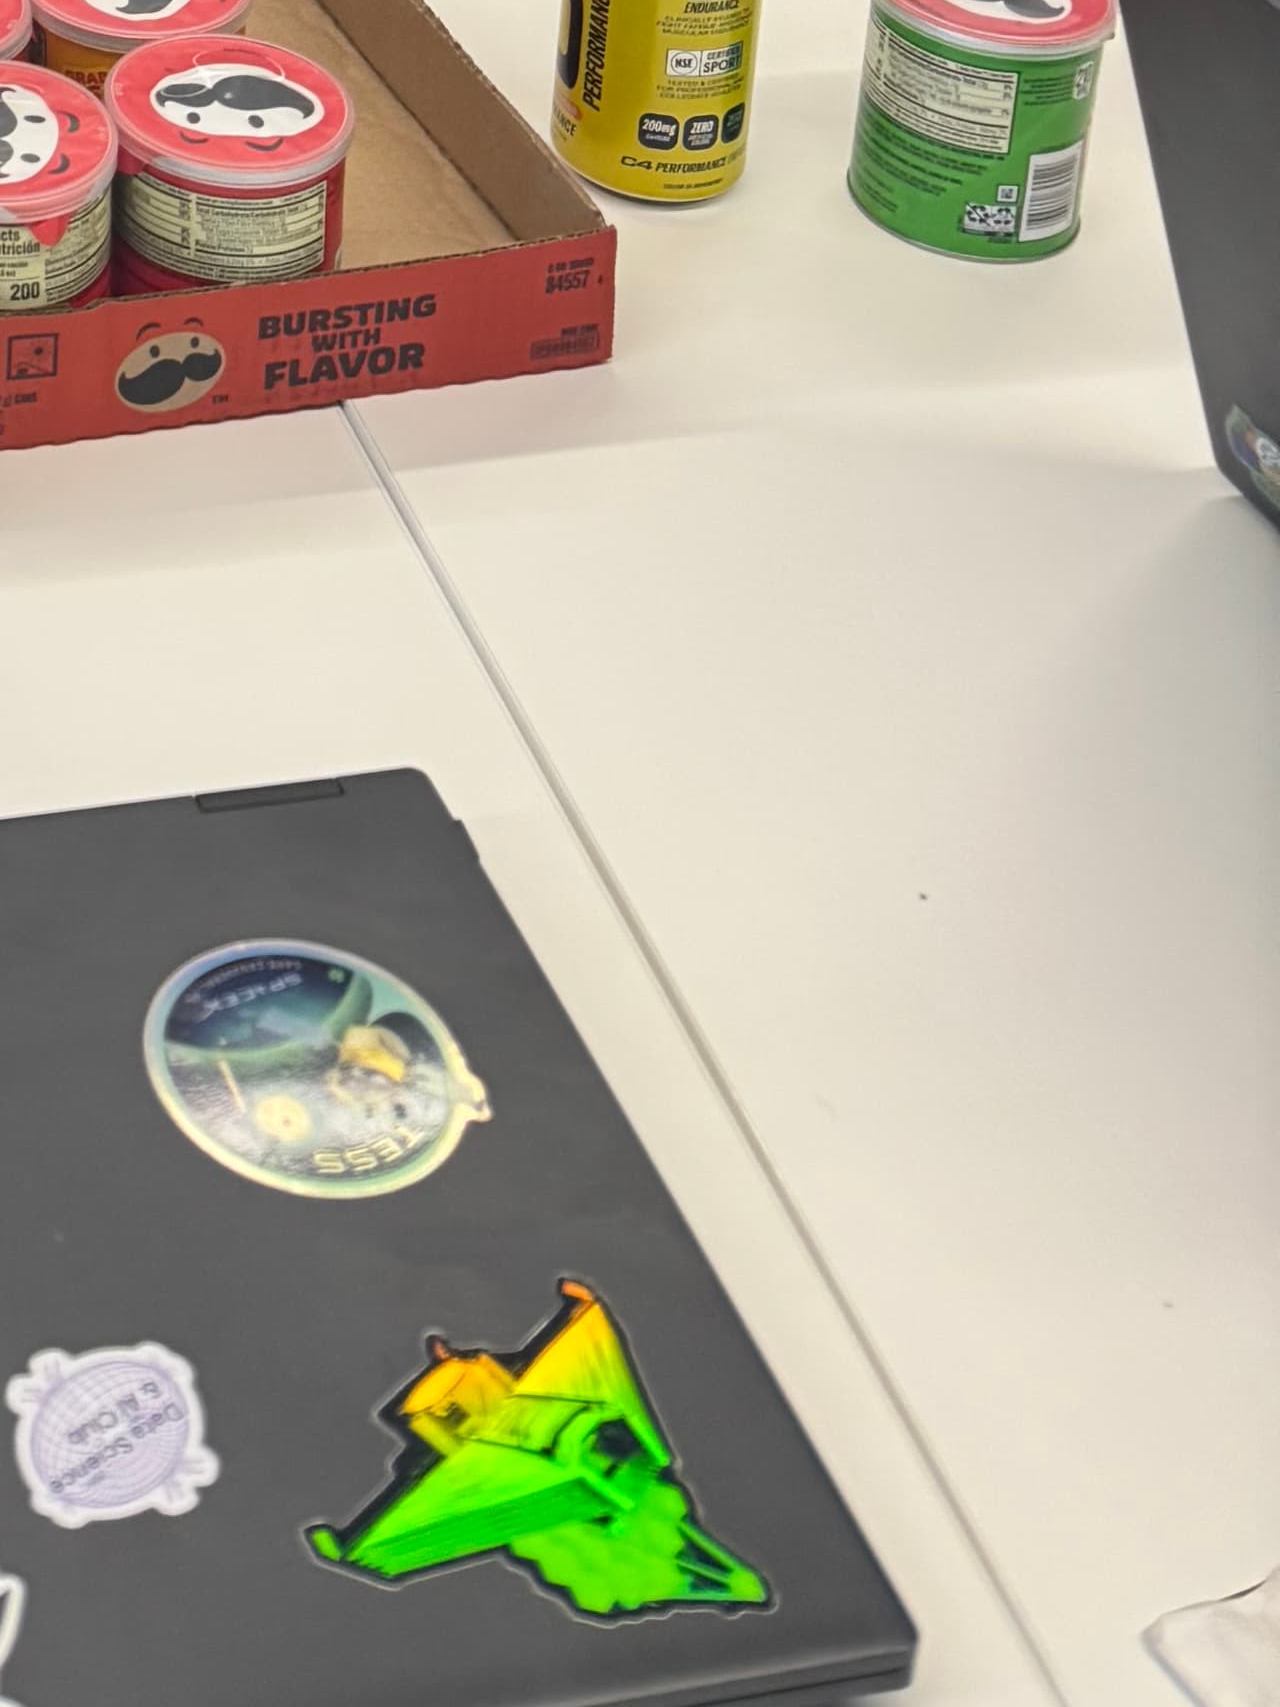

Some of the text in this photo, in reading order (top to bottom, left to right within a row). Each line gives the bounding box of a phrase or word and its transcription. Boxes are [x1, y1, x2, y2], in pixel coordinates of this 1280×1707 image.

[675, 57, 693, 69] NSF
[703, 56, 740, 73] SPORT
[642, 119, 676, 136] 200mg
[690, 120, 714, 133] ZERO
[620, 155, 654, 172] C4
[655, 157, 727, 173] PERFORMANCE
[10, 281, 39, 301] 200
[545, 270, 590, 294] 84557
[257, 294, 438, 341] BURSTING
[311, 326, 383, 354] WITH
[262, 341, 426, 390] FLAVOR
[312, 1124, 426, 1174] TESS
[142, 1381, 161, 1398] &
[67, 1411, 118, 1445] Club
[49, 1402, 185, 1493] Data Science
